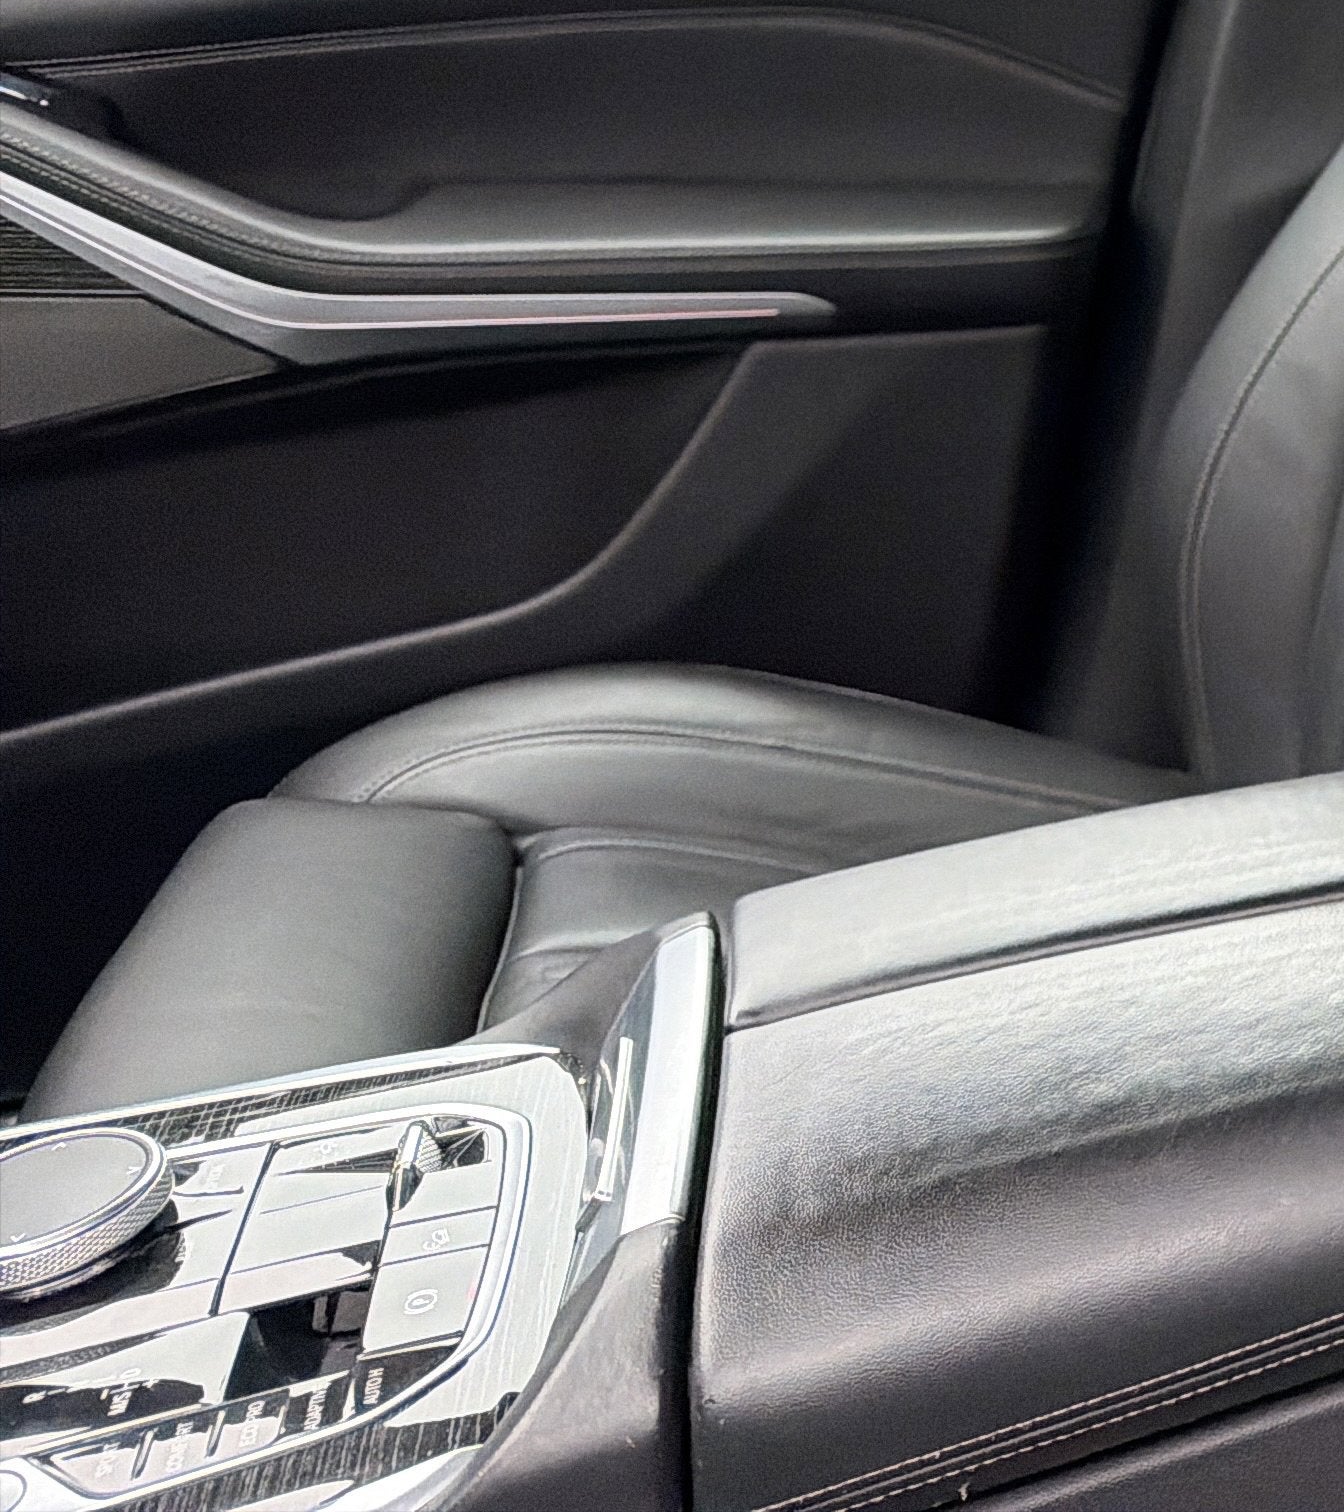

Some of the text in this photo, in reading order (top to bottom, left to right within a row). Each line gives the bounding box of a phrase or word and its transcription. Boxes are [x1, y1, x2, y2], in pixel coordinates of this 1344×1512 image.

[363, 1367, 385, 1405] AUTO H
[238, 1400, 266, 1448] ECO PRO
